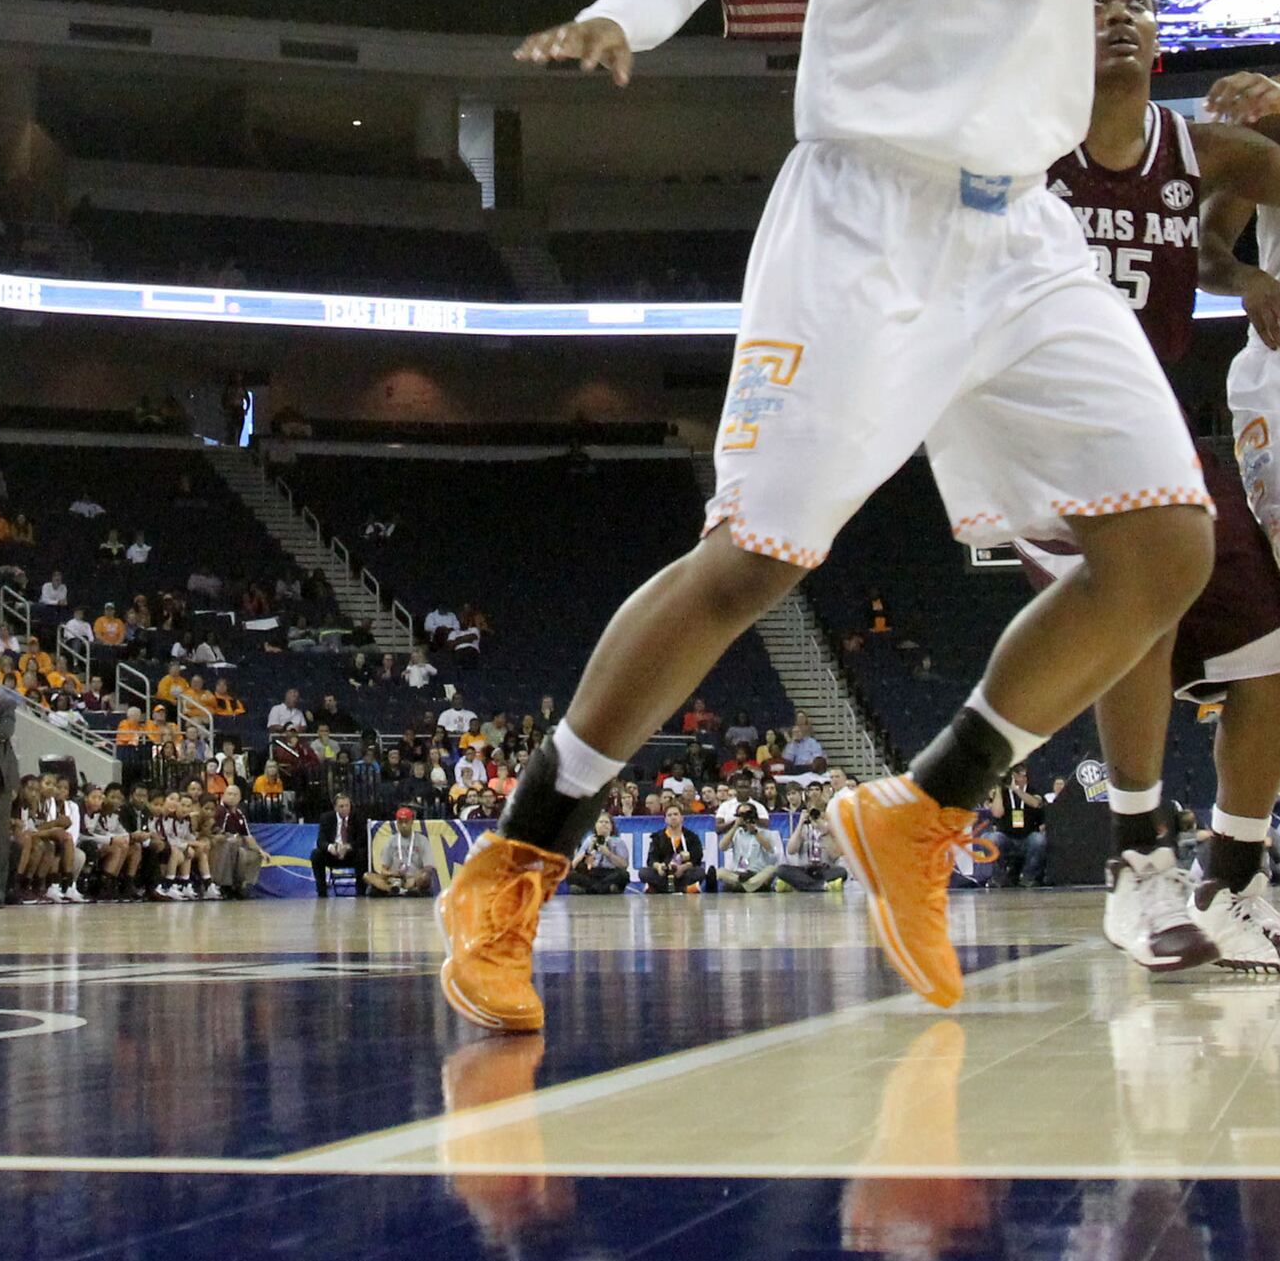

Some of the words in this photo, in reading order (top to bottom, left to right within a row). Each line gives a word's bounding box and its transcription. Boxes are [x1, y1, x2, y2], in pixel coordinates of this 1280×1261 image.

[1163, 181, 1192, 208] SEC
[1072, 206, 1135, 241] XAS
[1143, 212, 1199, 248] A&M
